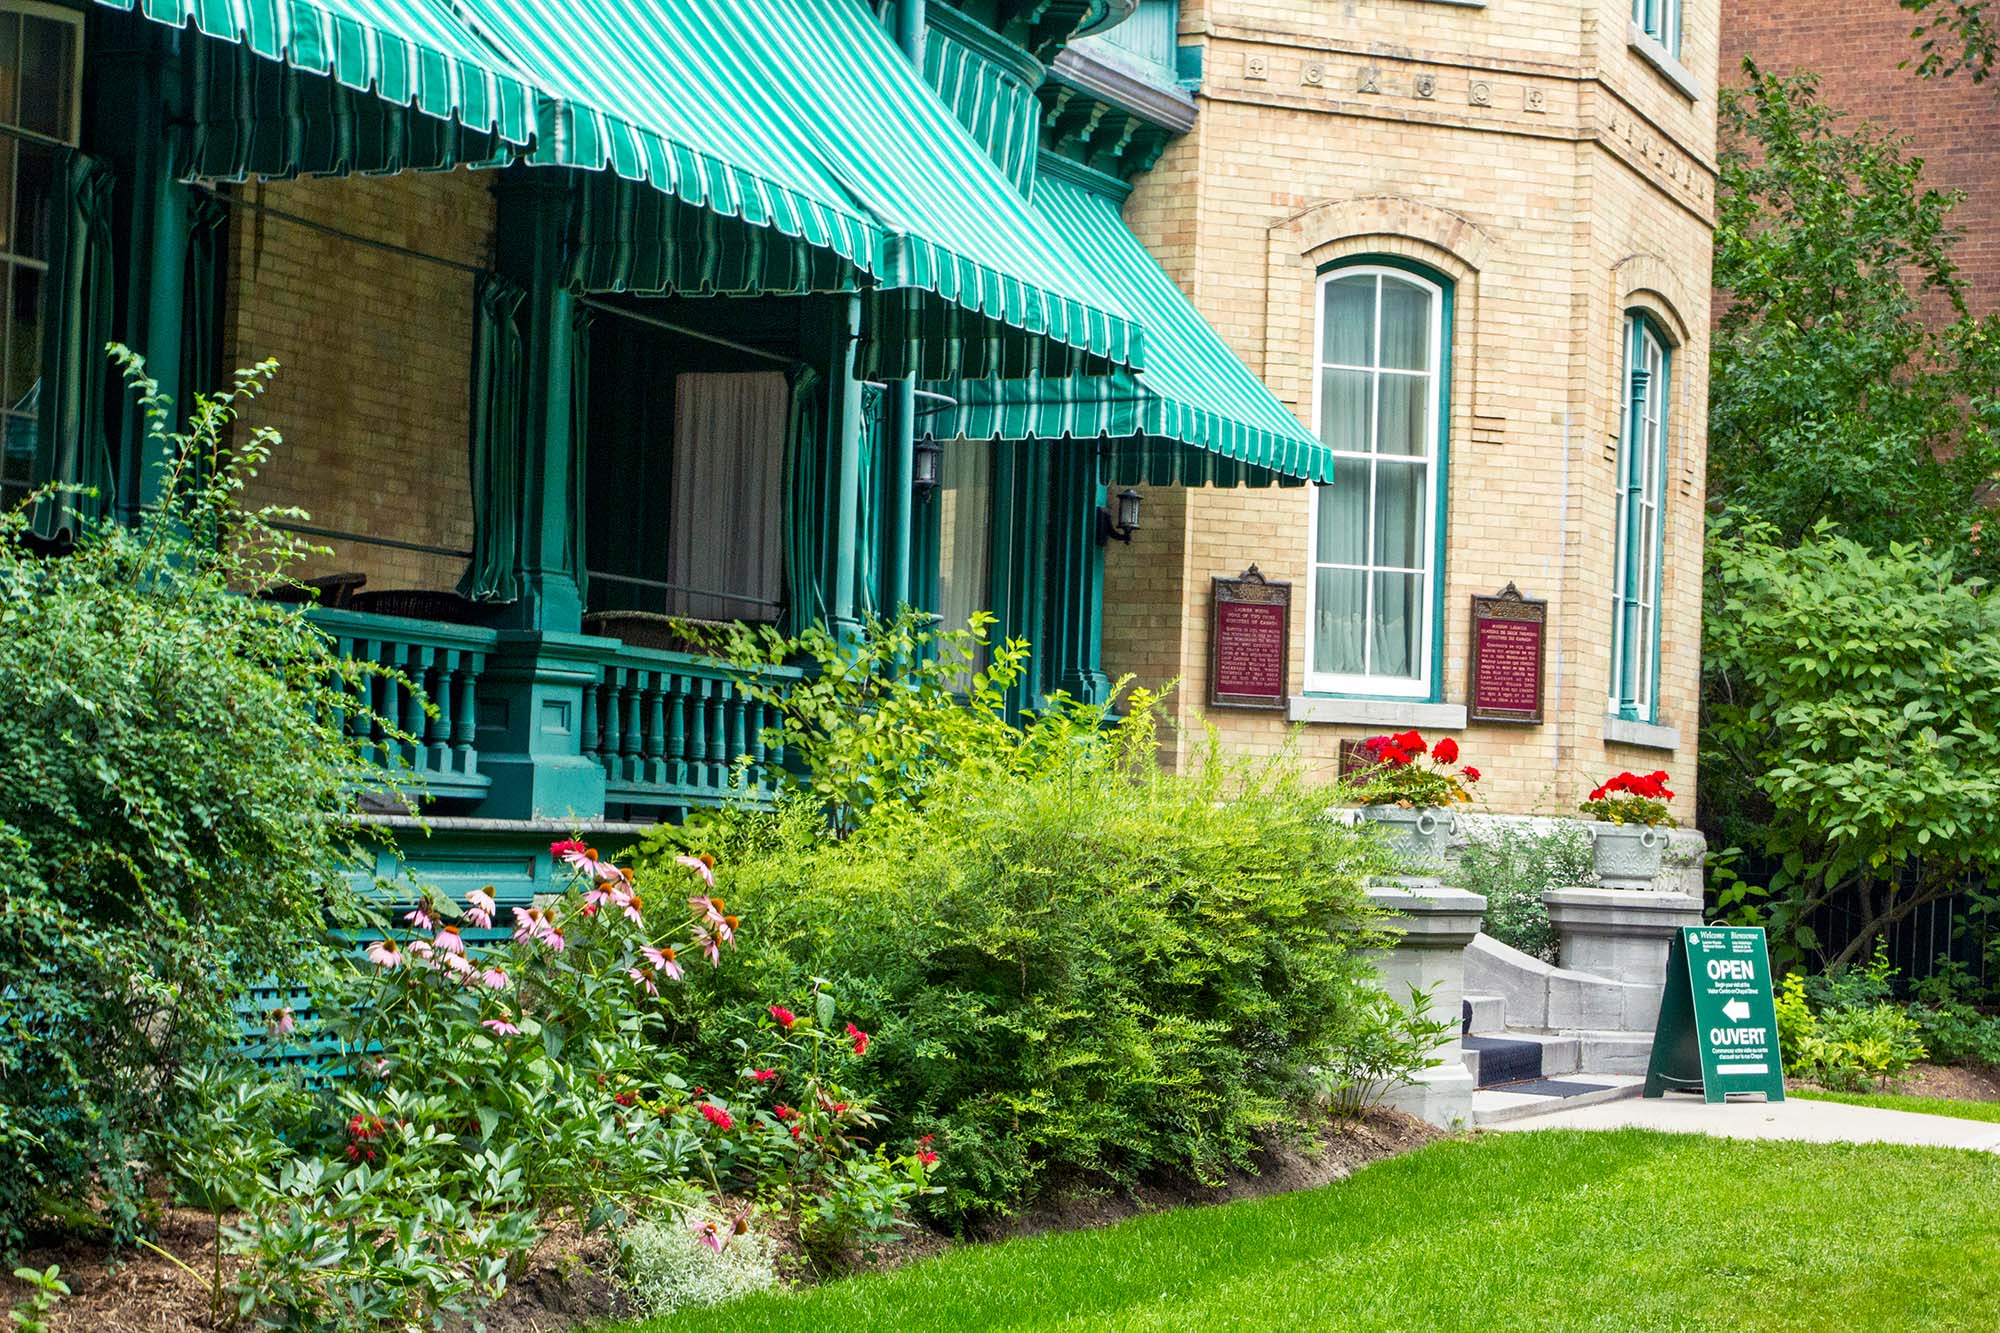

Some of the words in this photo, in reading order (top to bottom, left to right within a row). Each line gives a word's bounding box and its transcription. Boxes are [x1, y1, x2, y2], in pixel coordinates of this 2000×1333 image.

[1700, 931, 1725, 939] Welcome
[1731, 931, 1758, 940] Bienvenue
[1707, 959, 1755, 980] OPEN
[1710, 1027, 1766, 1046] OUVERT
